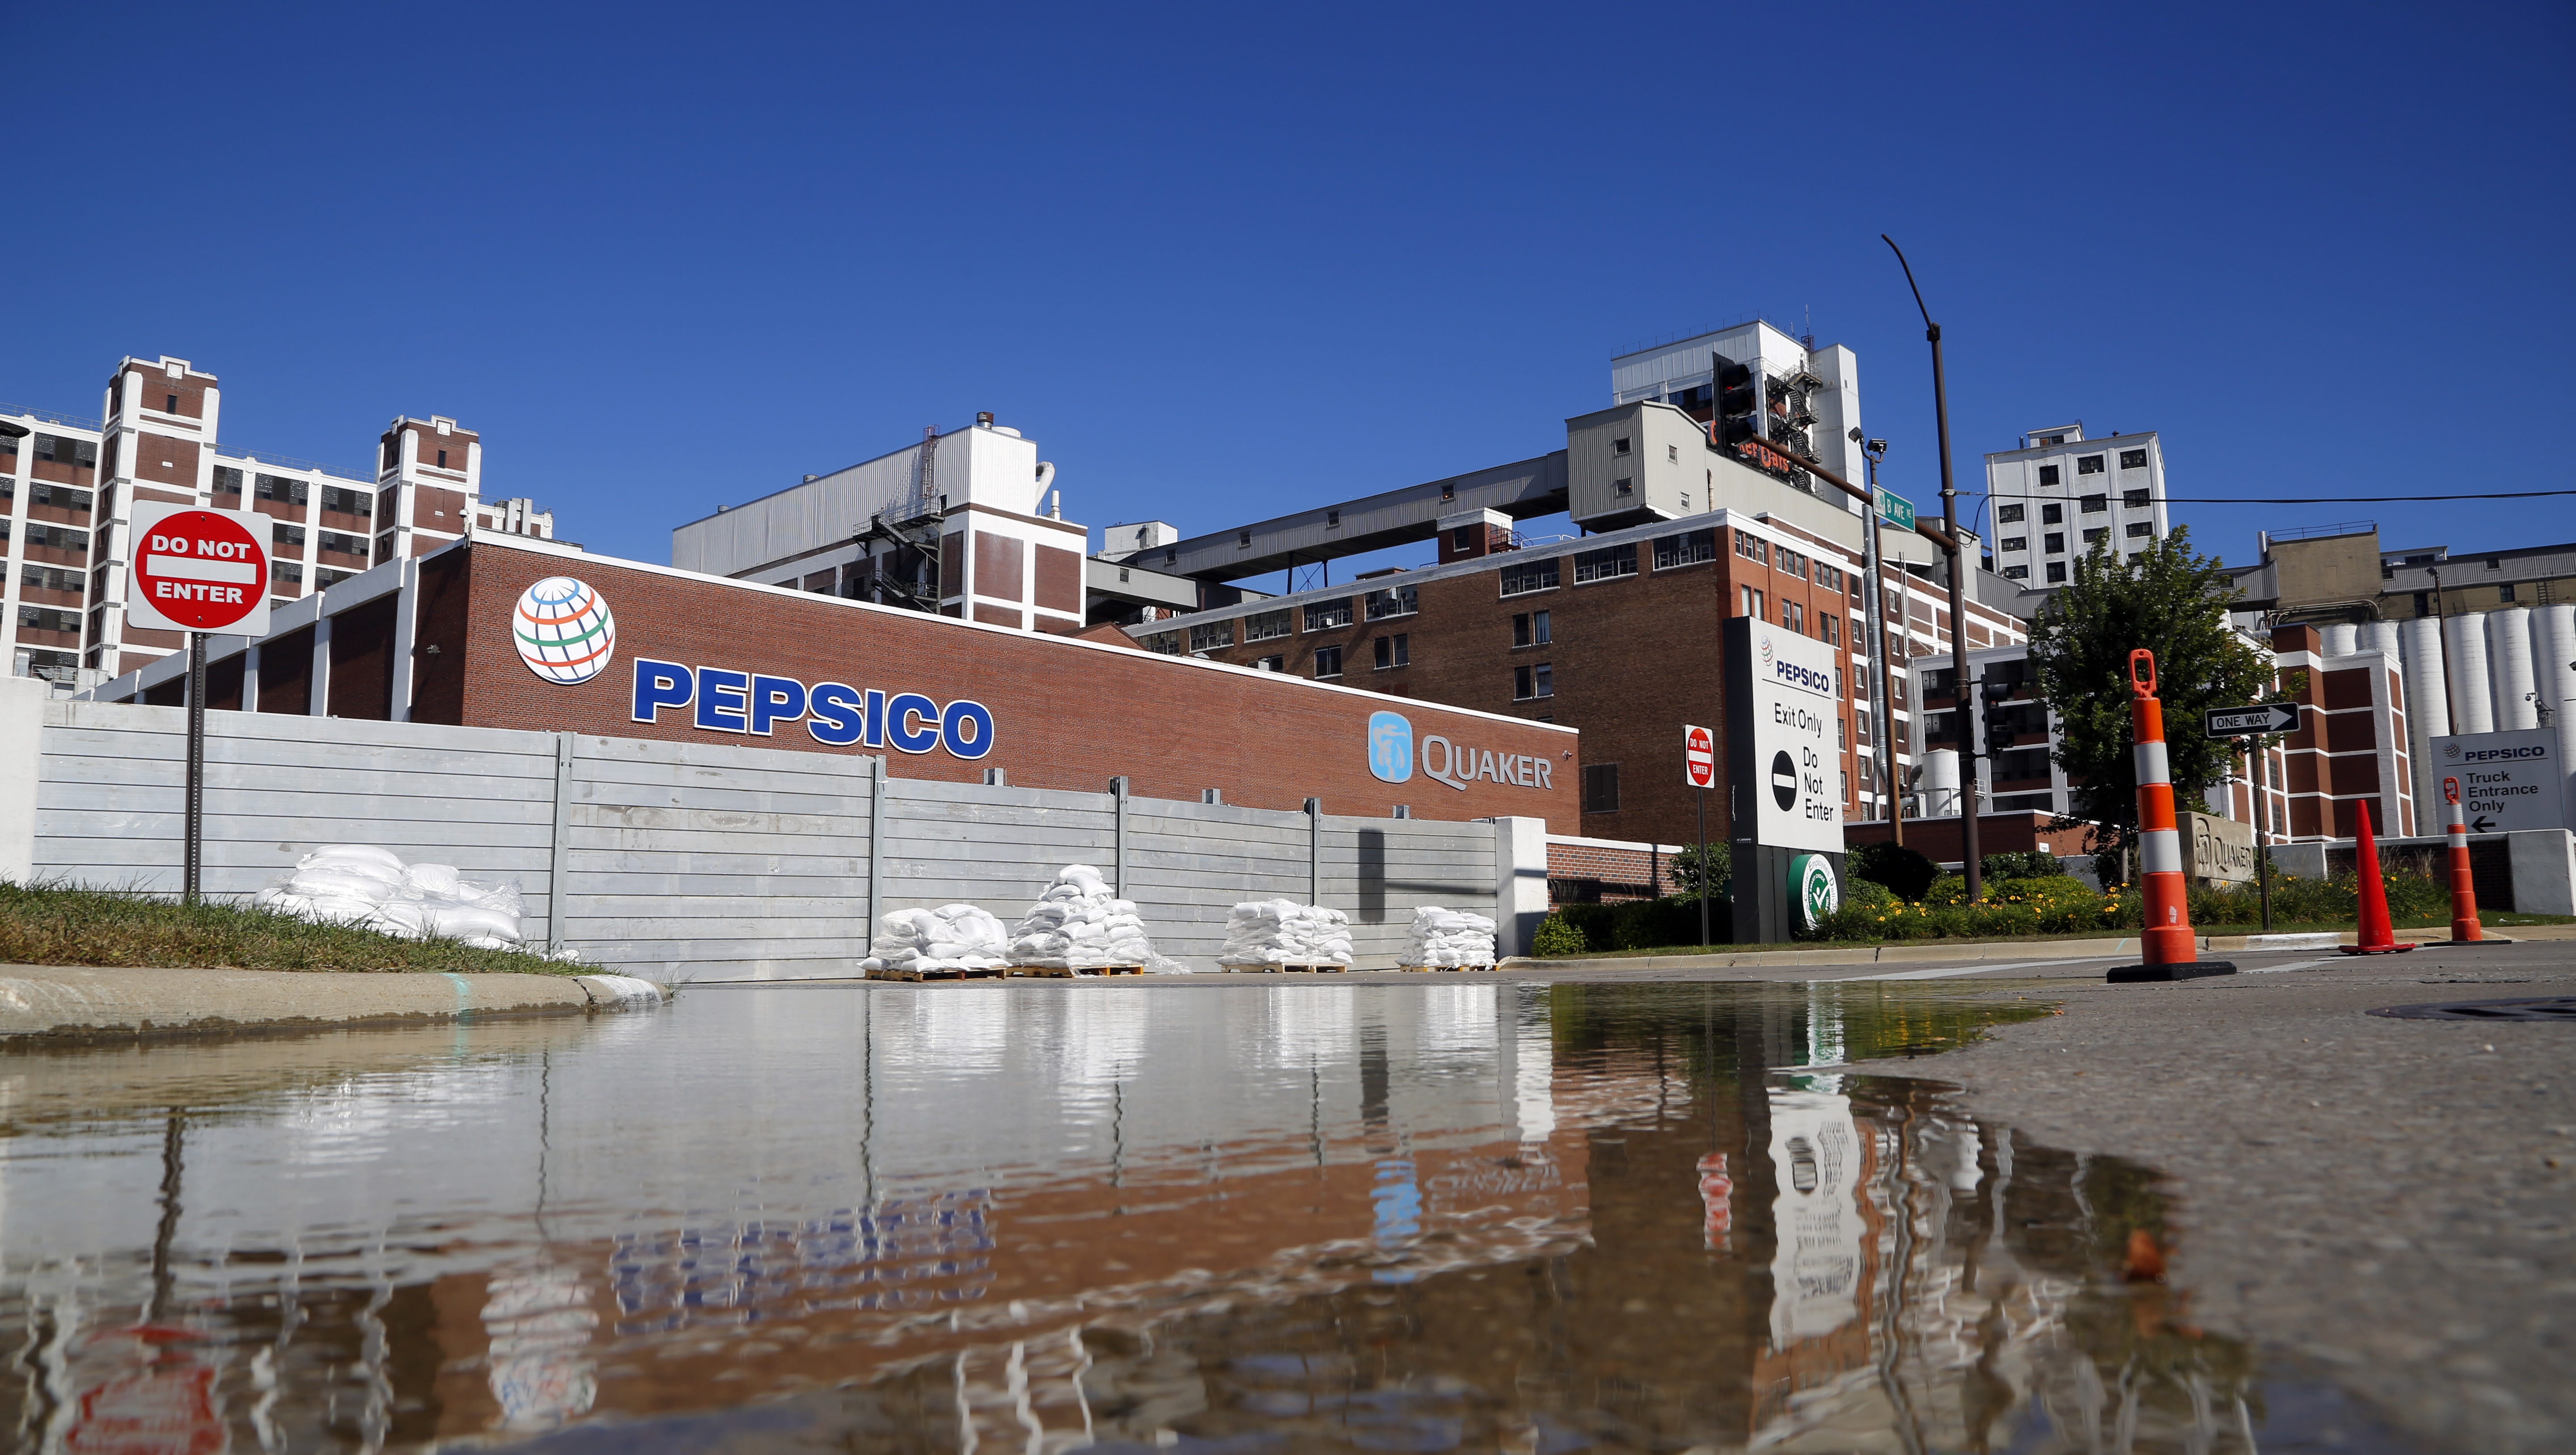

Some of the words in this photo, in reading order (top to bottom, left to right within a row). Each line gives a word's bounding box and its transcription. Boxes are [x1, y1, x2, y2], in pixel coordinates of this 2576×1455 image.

[1887, 498, 1891, 514] B
[1894, 502, 1905, 520] AVE
[1906, 508, 1912, 519] NE
[152, 535, 189, 554] DO
[197, 539, 250, 559] NOT
[156, 581, 243, 604] ENTER
[1776, 660, 1829, 692] PEPSICO
[631, 657, 995, 760] PEPSICO
[1775, 702, 1796, 728] Exit
[1798, 709, 1822, 738] Only
[2216, 716, 2241, 728] ONE
[2245, 713, 2270, 725] WAY
[1690, 738, 1697, 748] DO
[1699, 740, 1709, 750] NOT
[2465, 746, 2545, 761] PEPSICO
[1421, 735, 1553, 791] QUAKER
[1803, 746, 1818, 769] Do
[1693, 764, 1708, 775] ENTER
[2466, 771, 2511, 783] Truck
[1804, 772, 1823, 795] Not
[2468, 785, 2538, 798] Entrance
[1805, 798, 1834, 821] Enter
[2469, 800, 2504, 813] Only
[2215, 837, 2252, 872] QUAKER
[1809, 859, 1830, 876] Employees
